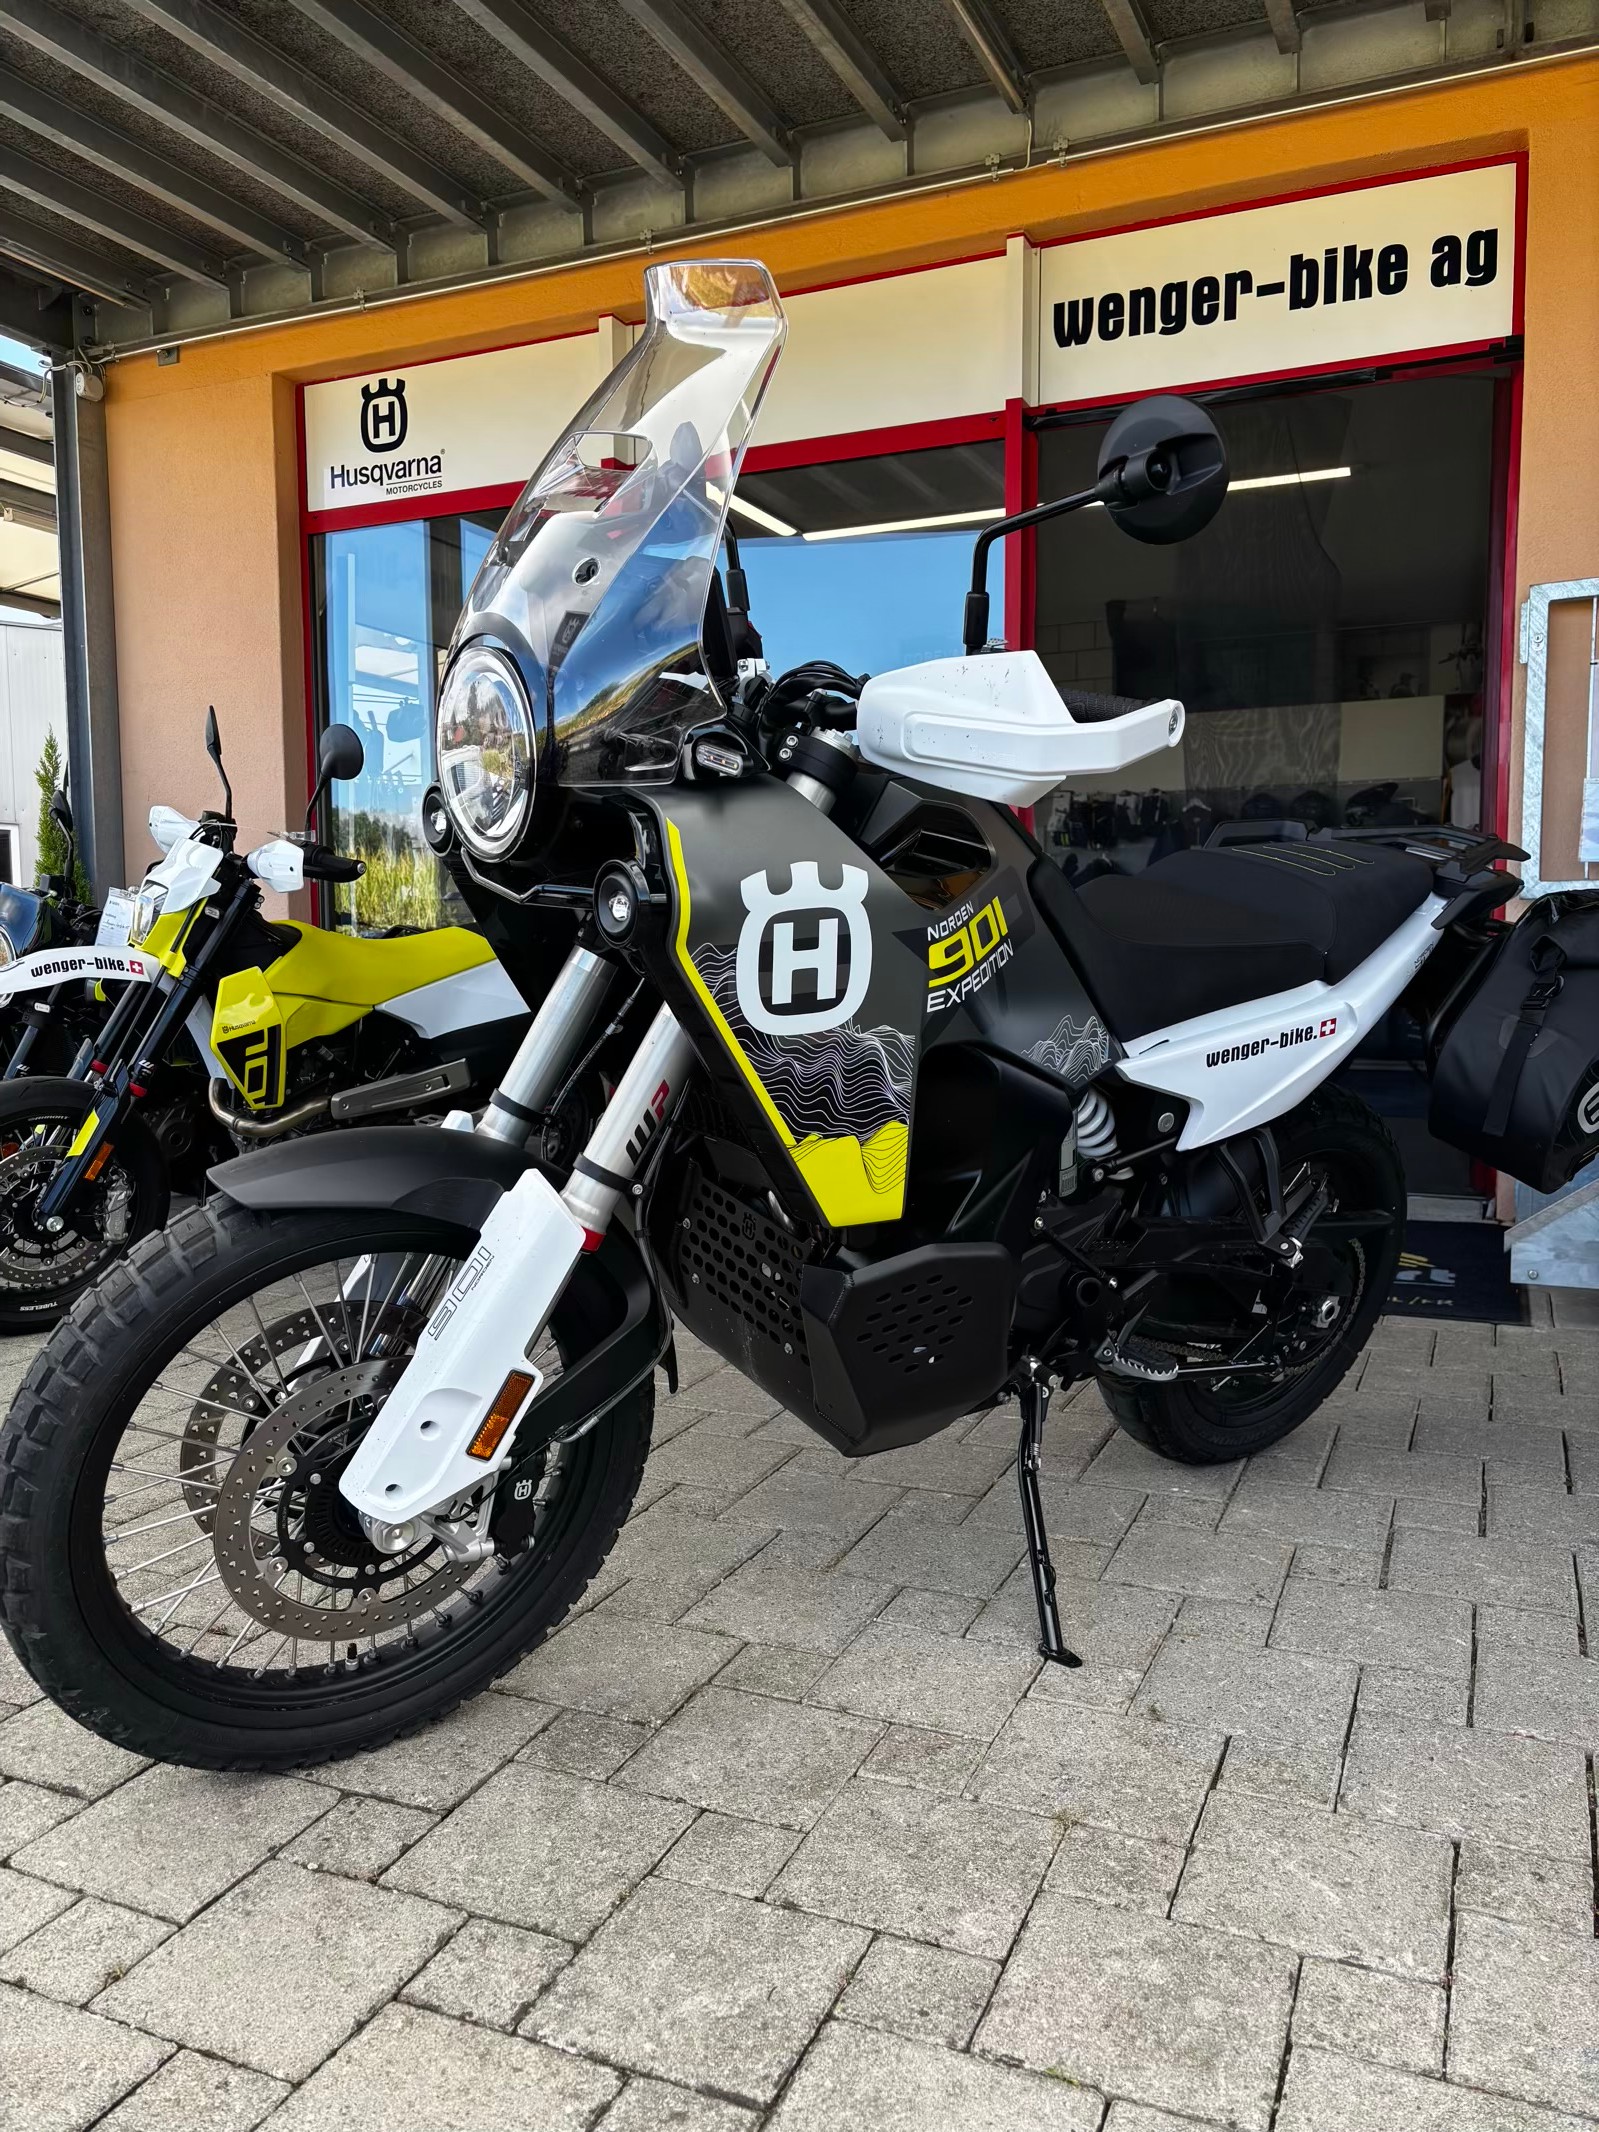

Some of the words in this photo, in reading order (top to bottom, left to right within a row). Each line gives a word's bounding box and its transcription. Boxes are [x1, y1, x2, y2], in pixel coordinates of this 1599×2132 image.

[1053, 242, 1409, 349] wenger-bike
[1430, 227, 1499, 288] ag
[330, 454, 443, 490] Husqvarna
[385, 480, 443, 496] MOTORCYCLES
[927, 900, 974, 942] NORDEN
[928, 895, 1009, 988] 901
[926, 938, 1014, 1014] EXPEDITION
[427, 1245, 492, 1341] 901
